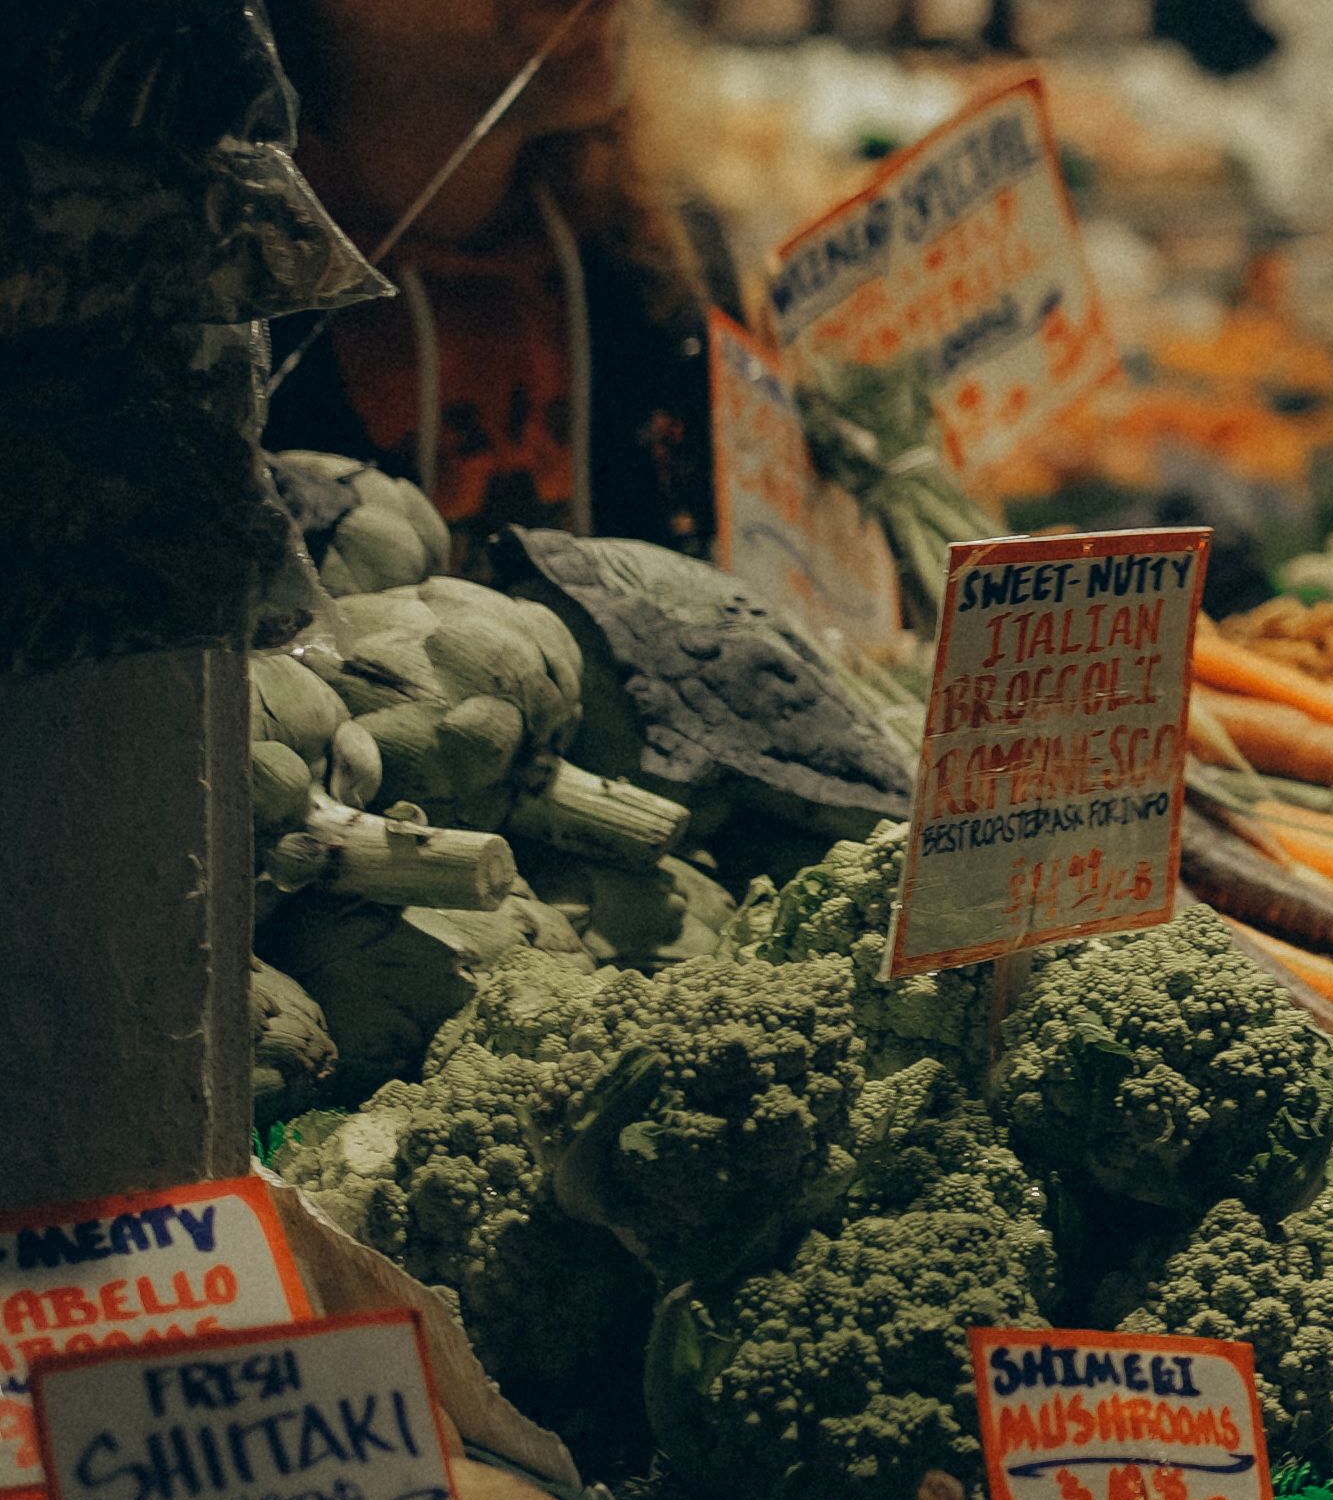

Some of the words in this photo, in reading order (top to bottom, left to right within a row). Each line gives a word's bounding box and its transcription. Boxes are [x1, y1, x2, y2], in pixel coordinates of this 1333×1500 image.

[982, 598, 1164, 669] ITALIAN
[940, 653, 1162, 734] BROCCOLI
[932, 723, 1178, 821] ROMANESCO
[16, 1204, 215, 1269] MEATY
[990, 1344, 1201, 1397] SHIMEGI
[1000, 1393, 1240, 1455] MUSHROOMS
